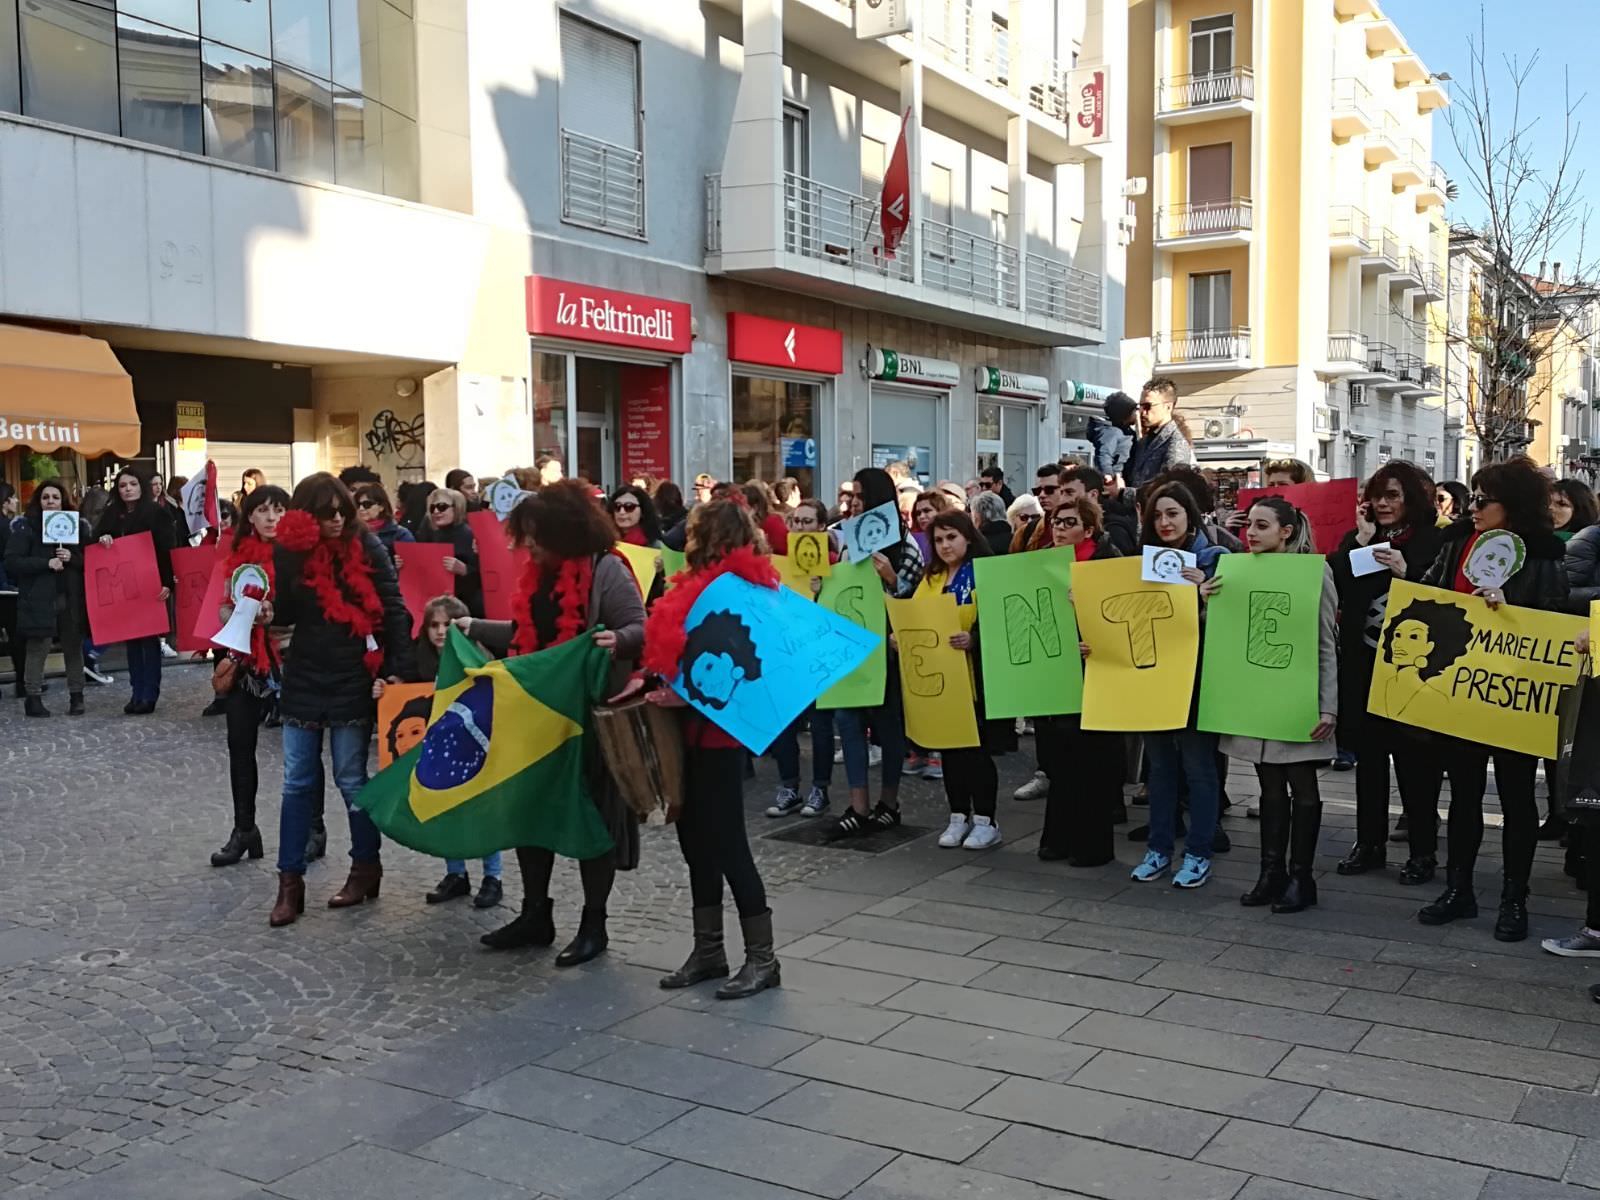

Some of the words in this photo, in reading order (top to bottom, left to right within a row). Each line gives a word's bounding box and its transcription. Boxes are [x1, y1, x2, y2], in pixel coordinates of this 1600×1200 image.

[556, 292, 577, 325] la
[579, 297, 674, 341] Feltrinelli
[900, 358, 925, 376] BNL
[1001, 374, 1022, 390] BNL
[1085, 387, 1100, 401] BNL
[0, 415, 80, 443] Bertini
[94, 560, 139, 606] M
[1003, 587, 1062, 665] N
[1101, 590, 1174, 669] T
[1246, 590, 1293, 669] E
[1470, 628, 1575, 667] MARIELLE
[899, 628, 944, 697] E
